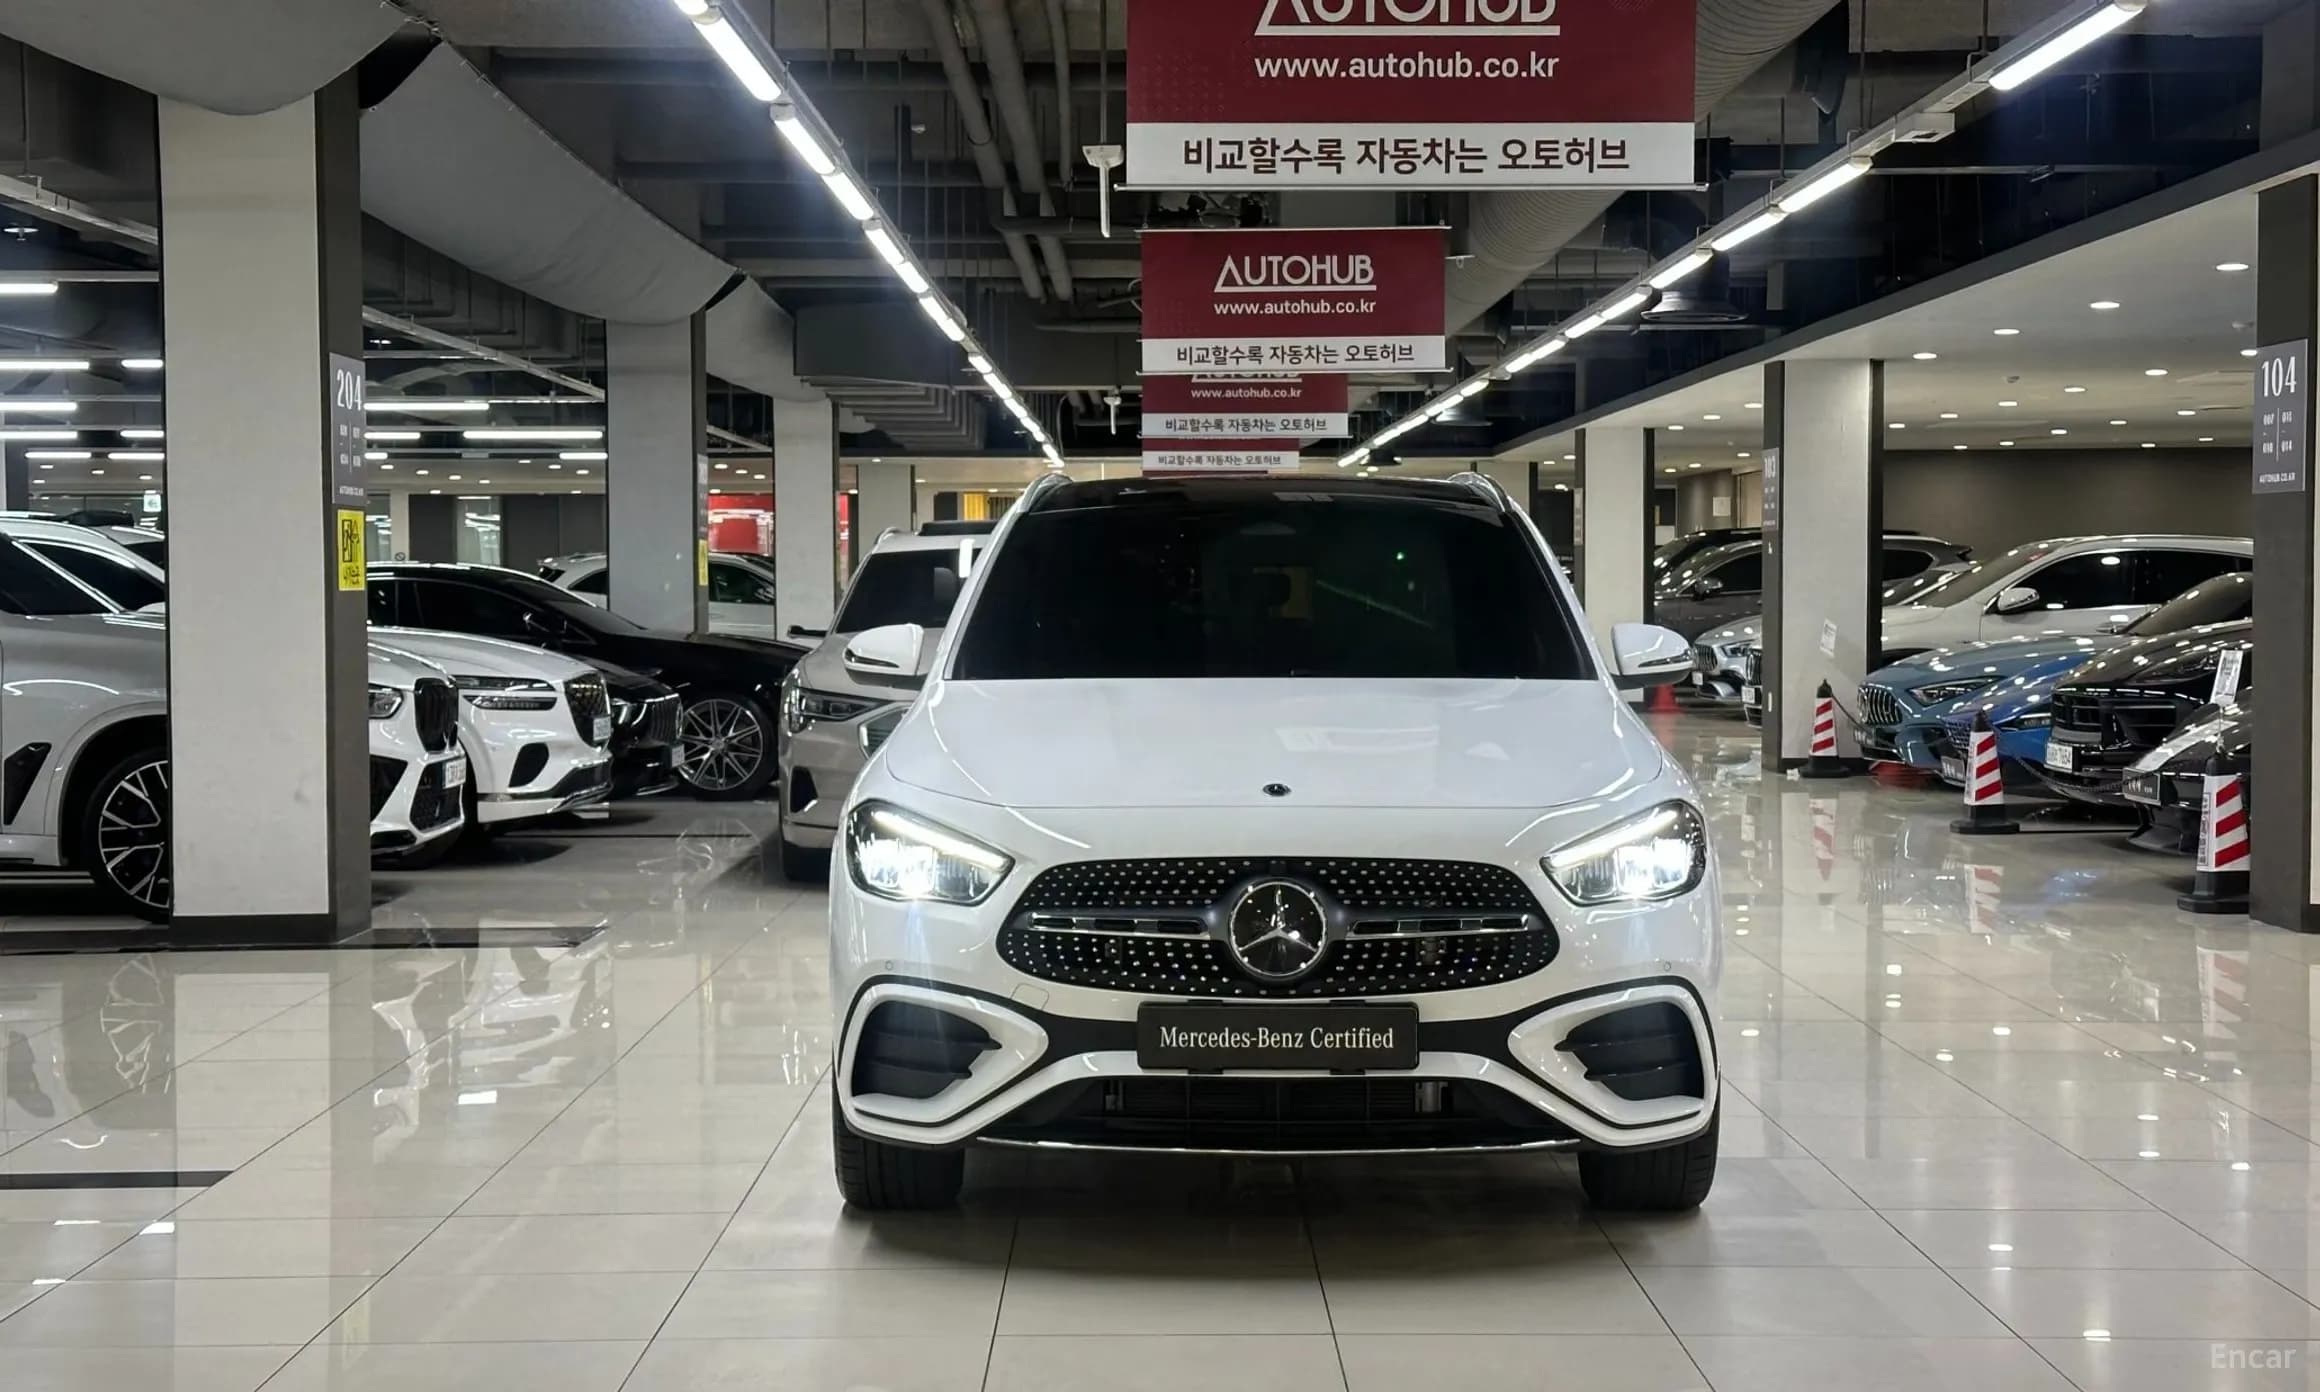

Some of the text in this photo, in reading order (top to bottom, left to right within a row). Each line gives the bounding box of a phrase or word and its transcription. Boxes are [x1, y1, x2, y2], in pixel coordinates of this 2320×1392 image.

[1254, 50, 1560, 78] www.autohub.co.kr
[1184, 137, 1630, 175] 비교할수록 자동차는 오토허브
[1214, 254, 1376, 293] AUTOHUB
[1214, 299, 1376, 315] www.autohub.co.kr
[1176, 343, 1415, 366] 비교할수록 자동차는 오토허브
[2261, 355, 2297, 398] 104
[336, 368, 363, 412] 204
[1191, 387, 1302, 399] www.autohub.co.kr
[1165, 417, 1328, 433] 비교할수록 자동차는 오토허브
[1159, 1026, 1394, 1049] Mercedes-Benz Certified
